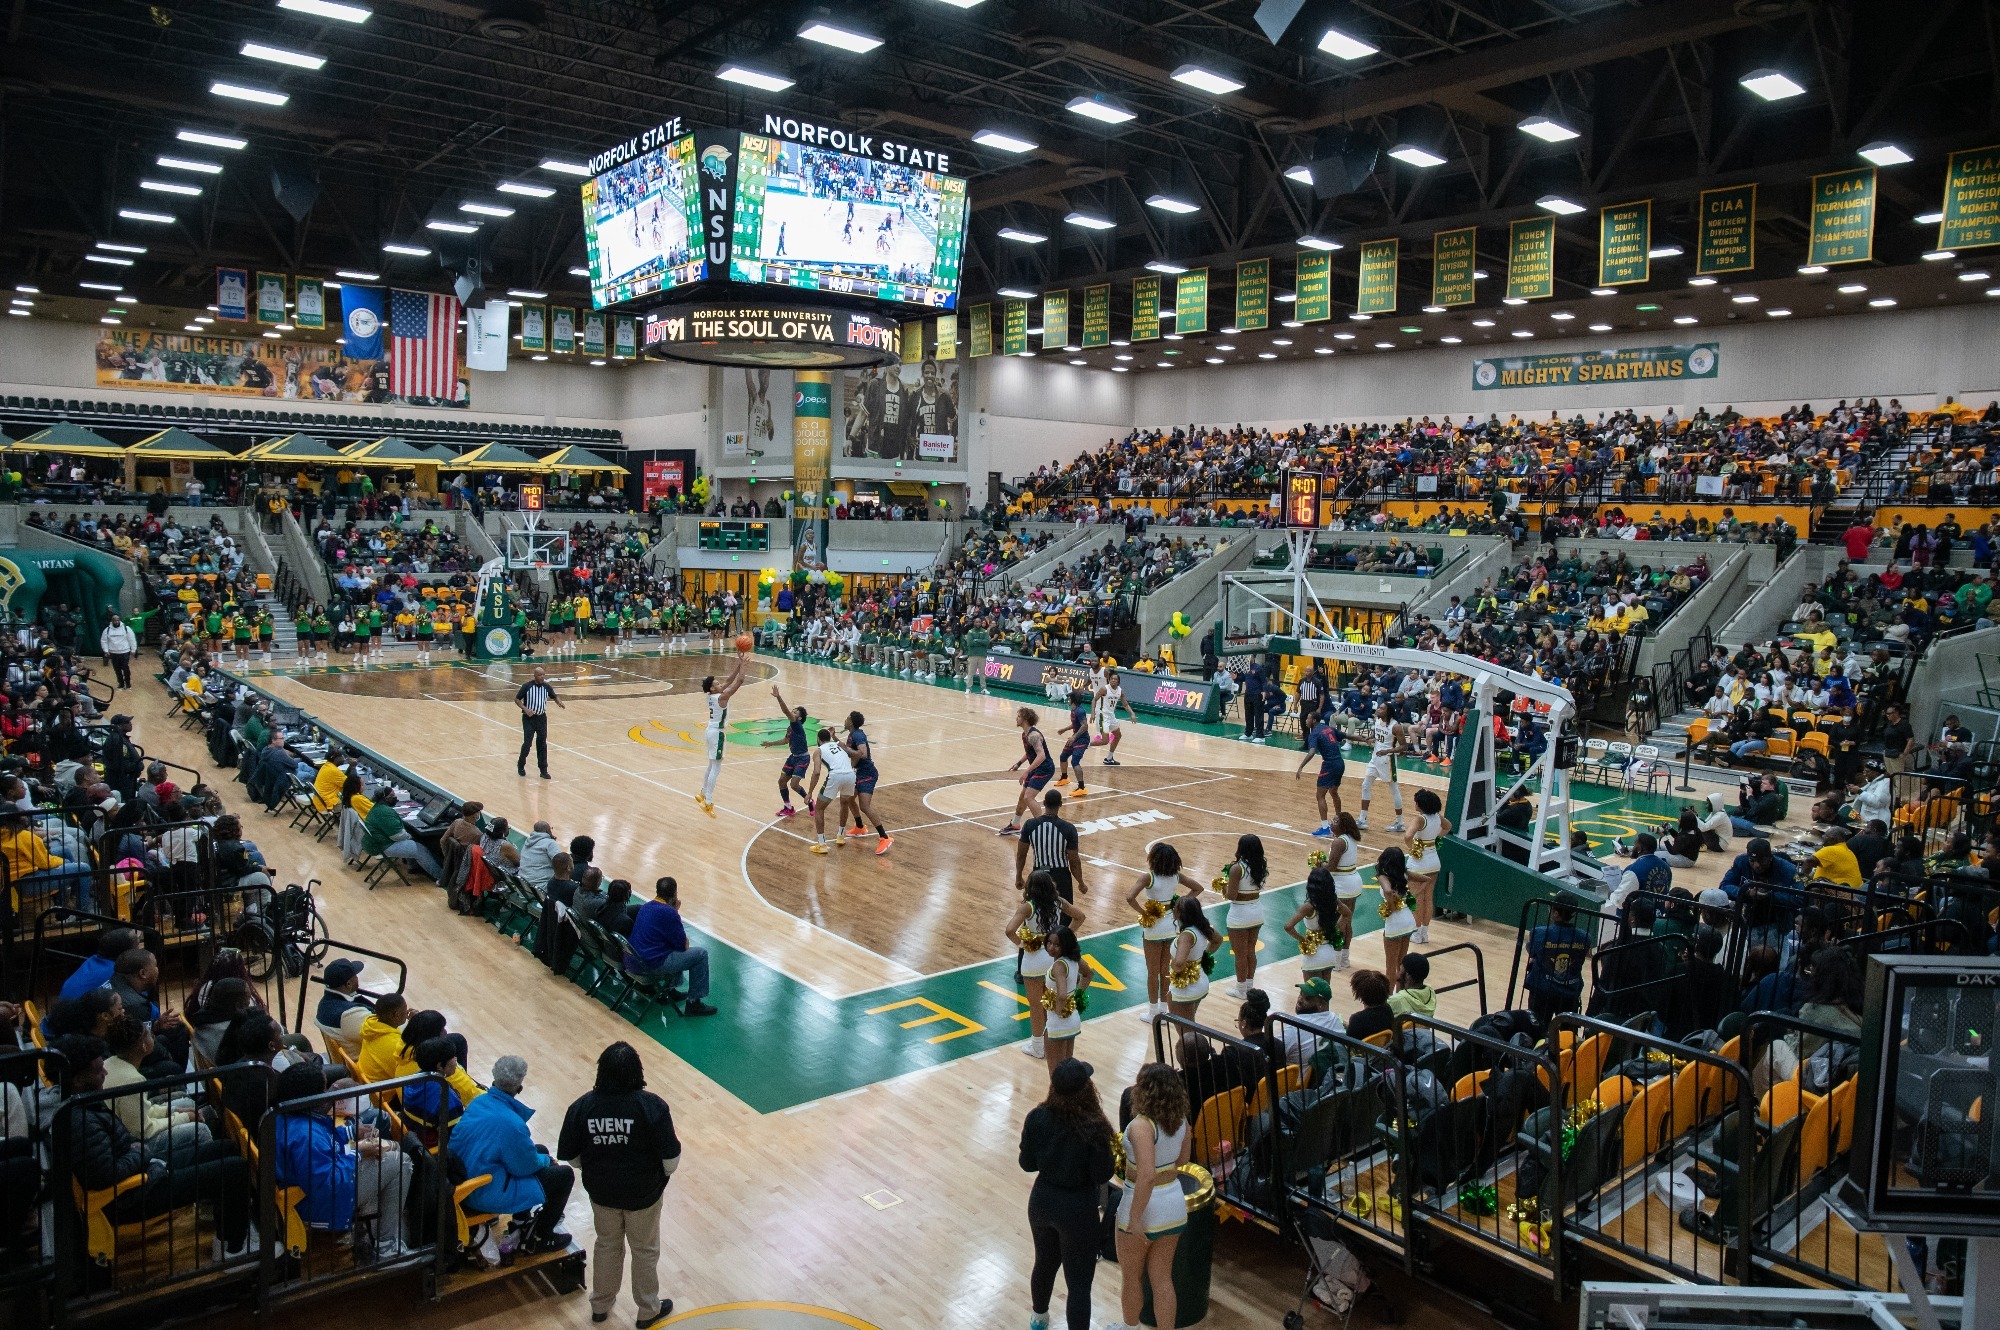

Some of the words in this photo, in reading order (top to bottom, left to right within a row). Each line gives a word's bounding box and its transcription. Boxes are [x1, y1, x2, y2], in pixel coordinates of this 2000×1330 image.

[589, 137, 638, 176] NORFOLK
[642, 117, 681, 151] STATE
[742, 136, 767, 152] NSU
[766, 114, 872, 155] NORFOLK
[882, 142, 949, 172] STATE
[944, 179, 964, 193] NSU
[1826, 179, 1863, 195] CIAA
[1712, 199, 1743, 213] CIAA
[1816, 197, 1871, 212] TOURNAMENT
[1960, 201, 1998, 213] WOMEN
[1614, 212, 1637, 220] WOMEN
[1824, 214, 1861, 226] WOMEN
[1615, 222, 1636, 231] SOUTH
[1708, 217, 1746, 227] NORTHERN
[1520, 230, 1545, 240] WOMEN
[1710, 227, 1742, 236] DIVISION
[1815, 229, 1868, 243] CHAMPIONS
[1960, 230, 1991, 241] 1995
[1443, 236, 1466, 248] CIAA
[1611, 234, 1641, 243] ATLANTIC
[1713, 237, 1739, 245] WOMEN
[1520, 241, 1544, 250] SOUTH
[1609, 245, 1640, 254] REGIONAL
[1368, 247, 1391, 258] CIAA
[1439, 249, 1470, 259] NORTHERN
[1706, 246, 1746, 256] CHAMPIONS
[1303, 257, 1324, 267] CIAA
[1514, 252, 1548, 263] ATLANTIC
[1606, 256, 1643, 266] CHAMPIONS
[1363, 260, 1395, 270] TOURNAMENT
[1440, 261, 1468, 271] DIVISION
[1512, 262, 1548, 273] REGIONAL
[1243, 266, 1263, 276] CIAA
[1298, 271, 1328, 281] TOURNAMENT
[1617, 268, 1632, 276] 1994
[1368, 273, 1388, 282] WOMEN
[1444, 272, 1464, 281] WOMEN
[1511, 273, 1550, 284] CHAMPIONS
[828, 277, 853, 292] 14:07
[1136, 281, 1156, 290] NCAA
[1239, 278, 1267, 287] NORTHERN
[1303, 283, 1323, 292] WOMEN
[912, 288, 918, 300] 7
[1242, 288, 1264, 297] DIVISION
[1362, 285, 1393, 294] CHAMPIONS
[1437, 284, 1471, 294] CHAMPIONS
[1520, 285, 1538, 294] 1993
[1048, 297, 1064, 306] CIAA
[1243, 298, 1261, 307] WOMEN
[1298, 295, 1328, 305] CHAMPIONS
[1445, 294, 1462, 302] 1993
[306, 300, 315, 308] 10
[1008, 301, 1023, 310] CIAA
[694, 310, 735, 318] NORFOLK
[740, 310, 769, 318] STATE
[774, 310, 832, 321] UNIVERSITY
[1238, 308, 1266, 317] CHAMPIONS
[692, 321, 724, 338] THE
[728, 321, 778, 338] SOUL
[782, 323, 807, 338] OF
[811, 324, 834, 341] VA
[112, 331, 141, 347] WE
[153, 335, 242, 357] SHOCKED
[1538, 356, 1576, 364] HOME
[1501, 367, 1572, 385] MIGHTY
[1578, 359, 1683, 381] SPARTANS
[805, 396, 827, 404] pepsi
[811, 421, 818, 429] a
[804, 448, 815, 456] of
[1292, 479, 1315, 493] 14:07
[528, 495, 538, 508] 16
[1298, 496, 1312, 522] 16
[493, 582, 504, 619] NSU
[1311, 641, 1334, 651] NORFOLK
[1354, 646, 1385, 656] UNIVERSITY
[1070, 668, 1085, 676] STATE
[709, 708, 714, 719] 2
[830, 747, 842, 755] 21
[587, 1118, 634, 1134] EVENT
[593, 1135, 629, 1144] STAFF
